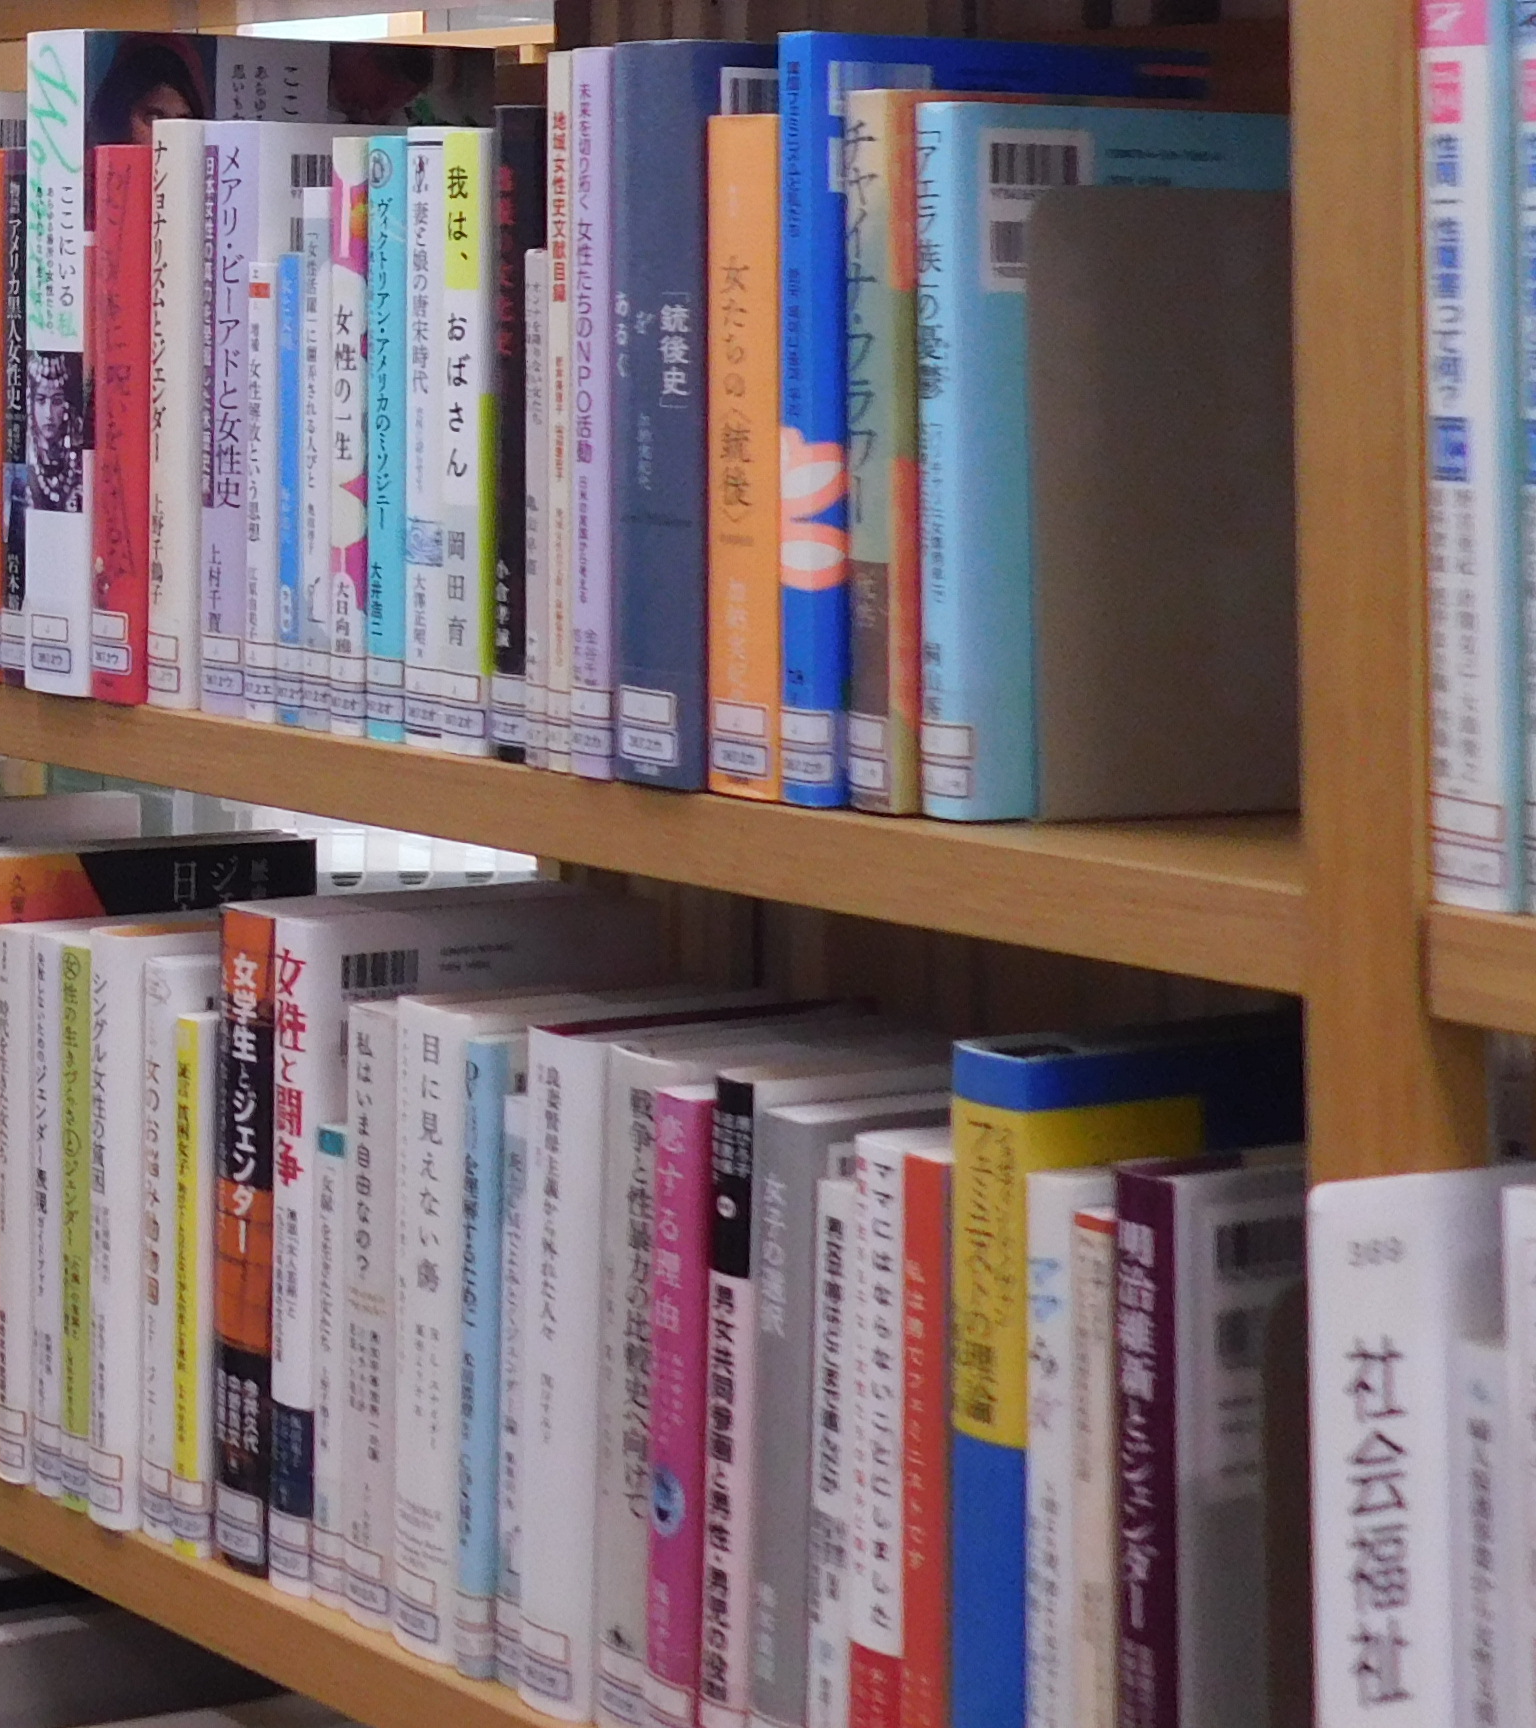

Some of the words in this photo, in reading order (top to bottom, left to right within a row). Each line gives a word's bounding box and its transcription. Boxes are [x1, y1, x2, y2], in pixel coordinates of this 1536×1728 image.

[4, 216, 24, 412] アメリカ黒人女性史
[150, 139, 169, 467] ナショナリズムとジェンダー
[411, 199, 430, 394] 妻と娘の唐宋時代
[445, 166, 469, 261] 我は、
[550, 110, 568, 305] 地域女性史文献目録
[842, 116, 880, 523] チャイナ・フラワー
[214, 145, 242, 512] メアリ・ビーアドと女性史
[304, 230, 320, 490] 「女性活躍」に翻弄される人びと
[332, 302, 355, 463] 女性の一生
[372, 195, 394, 531] ヴィクトリアン・アメリカのミソジニー
[445, 313, 468, 479] おばさん
[576, 213, 595, 465] 女性たちのNPO活動
[614, 292, 631, 379] あるく
[659, 290, 693, 409] 「銃後史」
[718, 257, 754, 527] 女たちの〈銃後〉
[246, 359, 262, 545] 女性解放という思想
[445, 529, 467, 647] 岡田育
[91, 971, 106, 1195] シングル女性の貧困
[228, 950, 259, 1253] 女学生とジェンダー
[273, 950, 307, 1189] 女性と闘争
[418, 1030, 440, 1293] 目に見えない傷
[542, 1064, 560, 1340] 良妻賢母主義から外れた人々
[622, 1086, 654, 1522] 戦争と性暴力の比較史へ向けて
[654, 1114, 685, 1334] 恋する理由
[1346, 1334, 1415, 1709] 社会福祉
